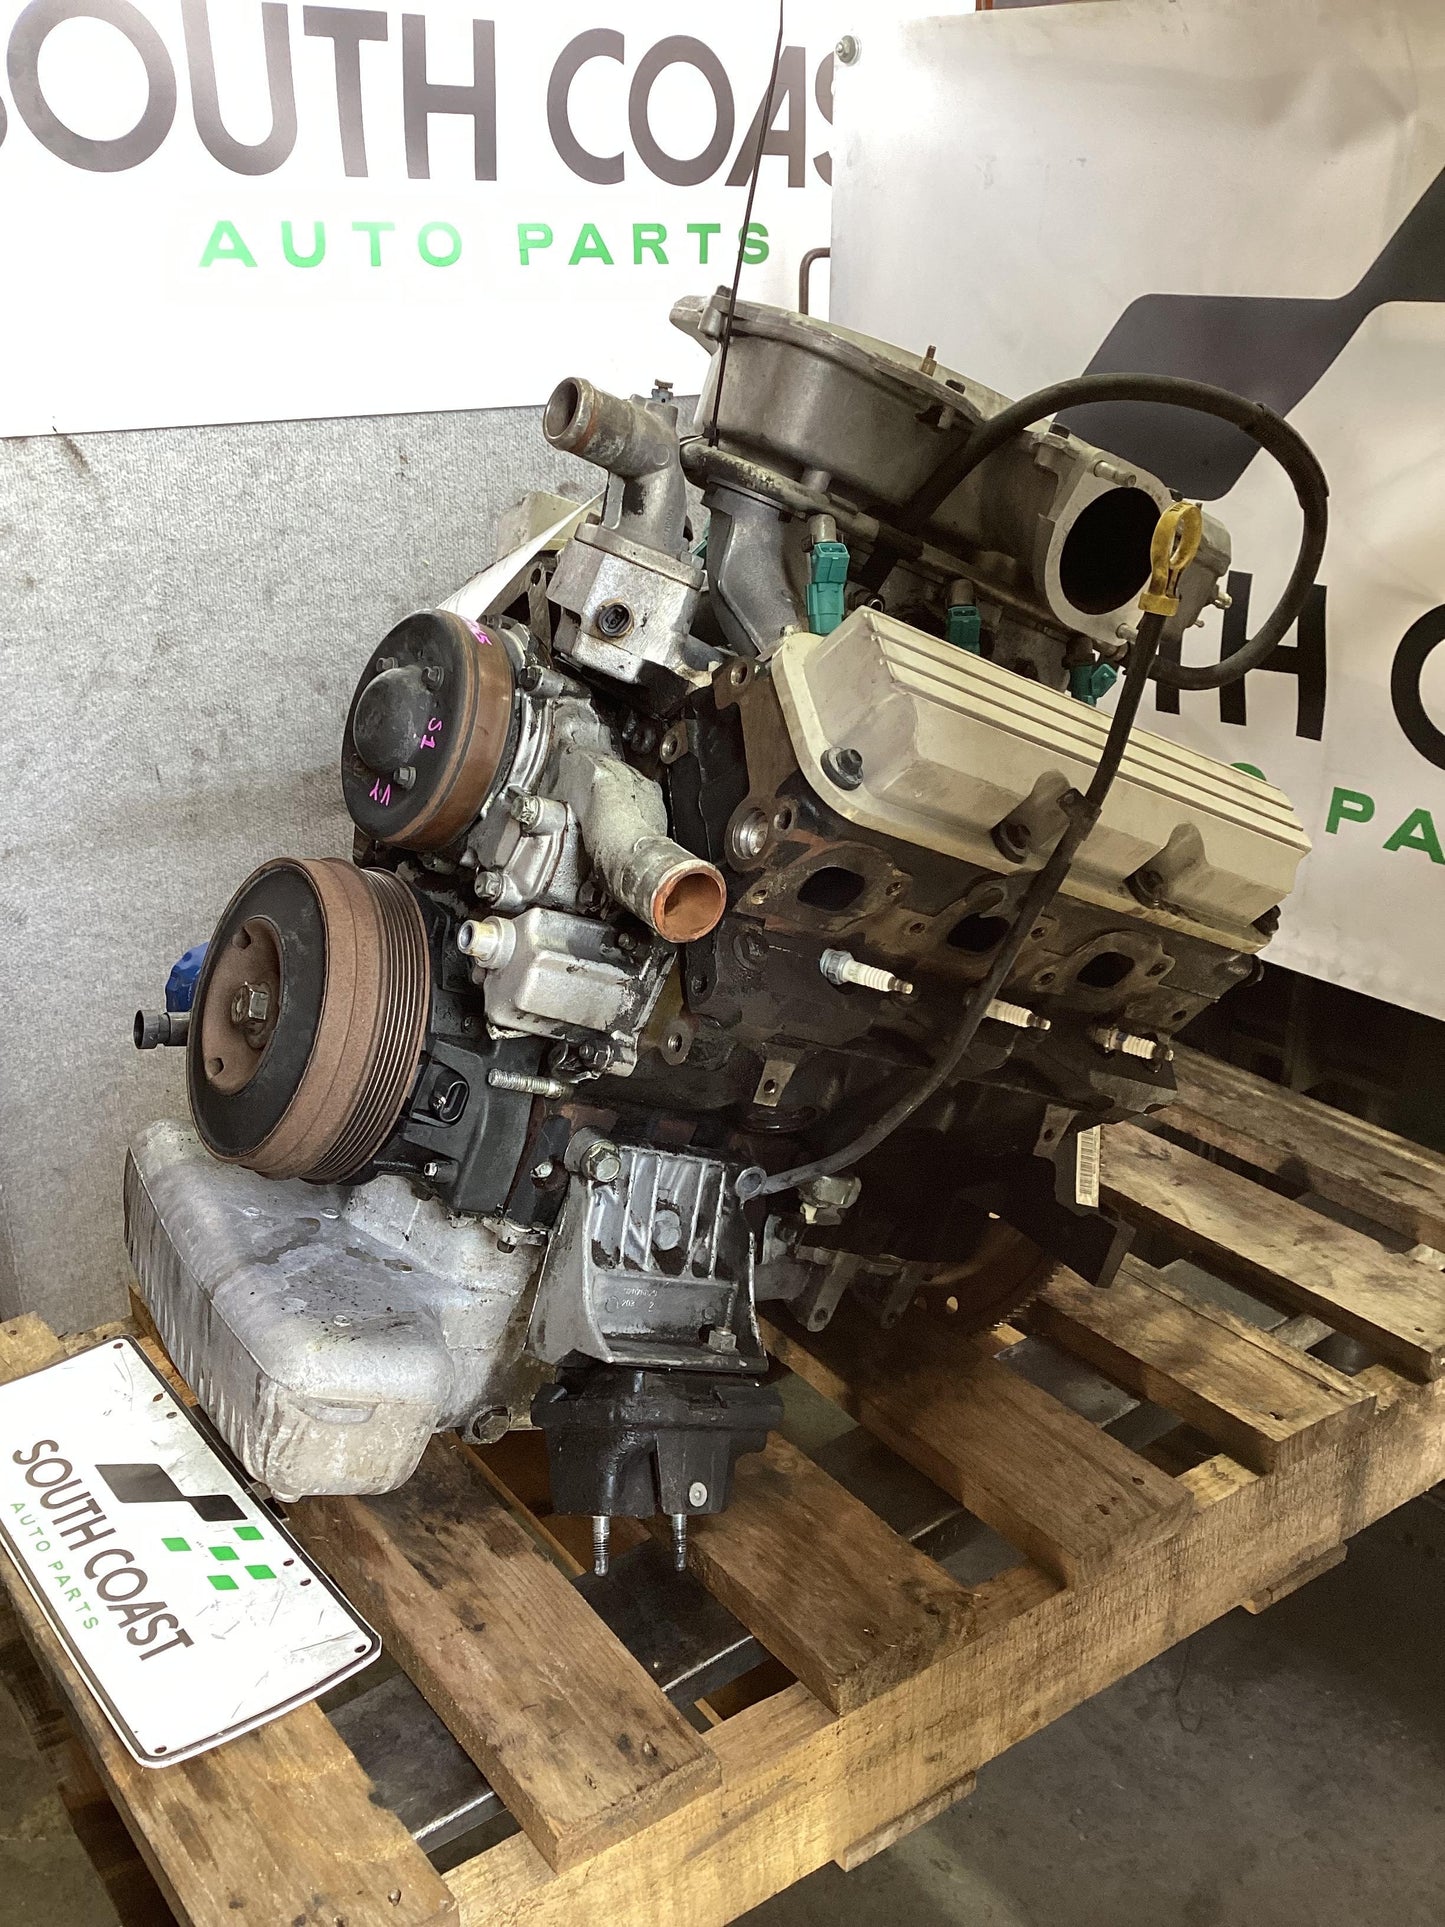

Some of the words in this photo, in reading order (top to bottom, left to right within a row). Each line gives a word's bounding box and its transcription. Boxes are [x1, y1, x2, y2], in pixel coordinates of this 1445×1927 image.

[0, 0, 498, 181] OUTH
[199, 220, 463, 269] AUTO
[517, 222, 770, 267] PARTS
[10, 1502, 51, 1552] AUTO
[48, 1560, 99, 1630] PARTS
[12, 1439, 117, 1551] SOUTH
[84, 1548, 195, 1661] COAST
